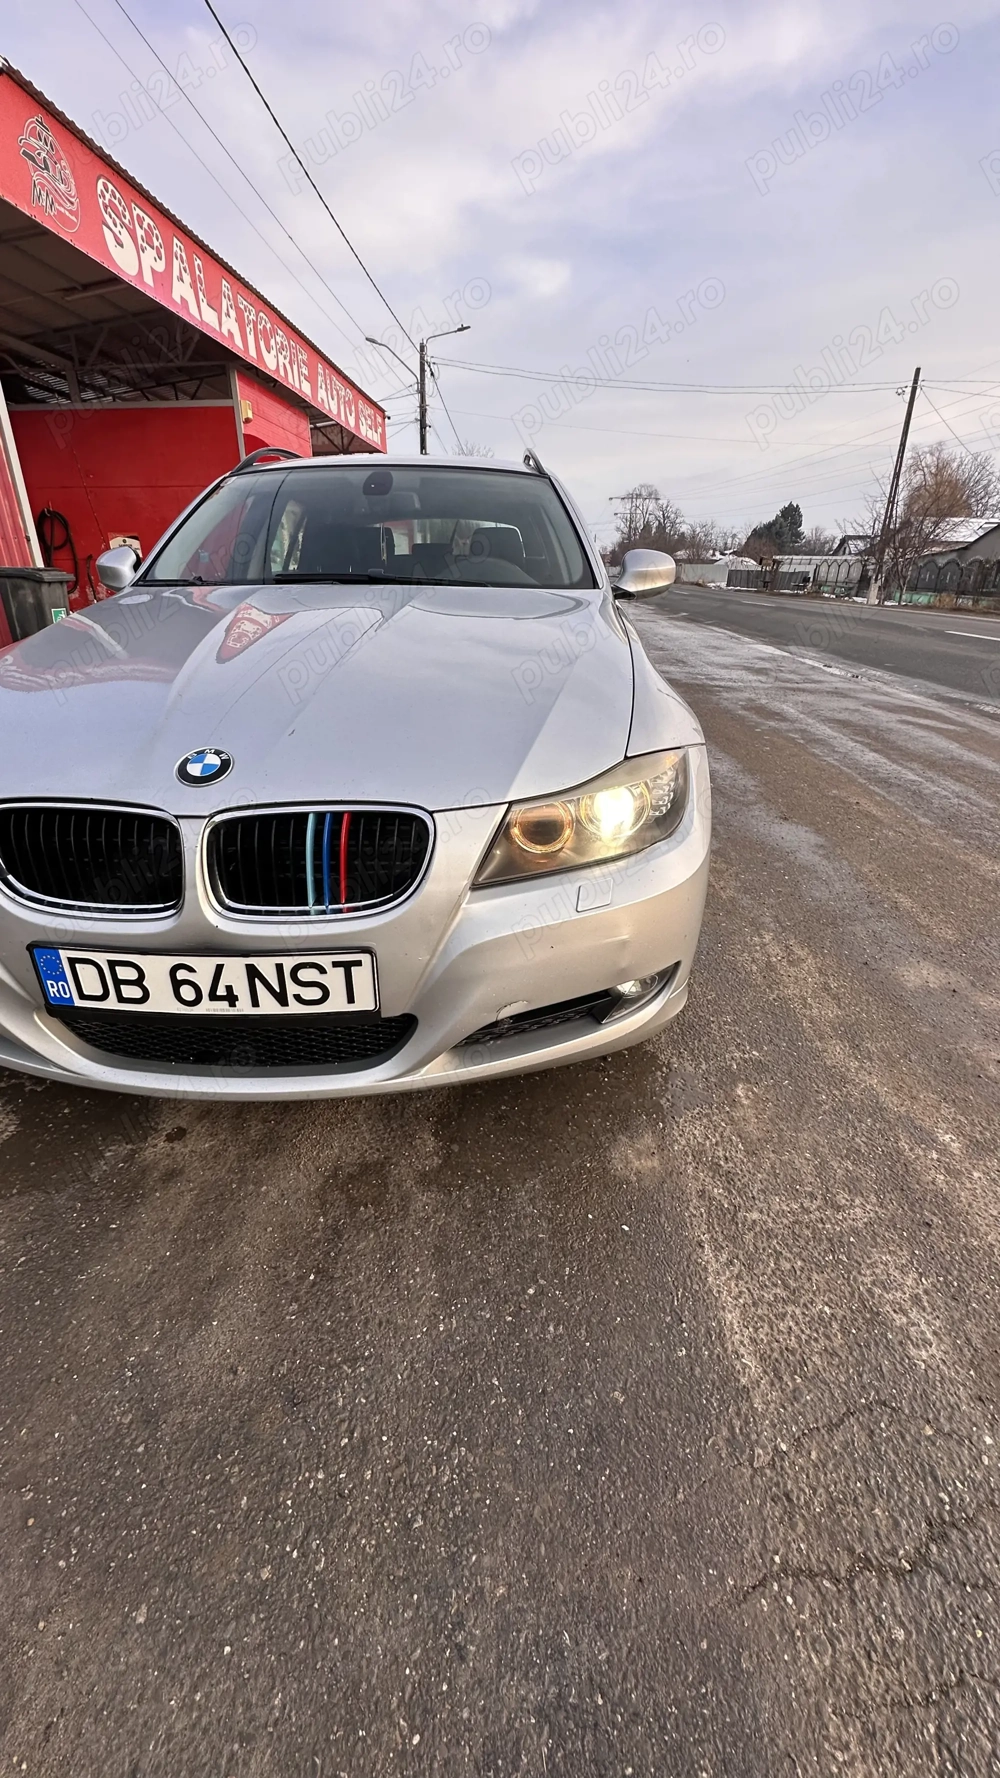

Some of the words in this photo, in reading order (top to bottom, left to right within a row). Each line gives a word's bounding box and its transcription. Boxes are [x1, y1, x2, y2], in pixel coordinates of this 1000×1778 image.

[96, 174, 312, 397] SPALATORIE
[317, 362, 356, 429] AUTO
[357, 400, 383, 446] SELF
[46, 979, 71, 999] RO
[66, 957, 151, 1005] DB
